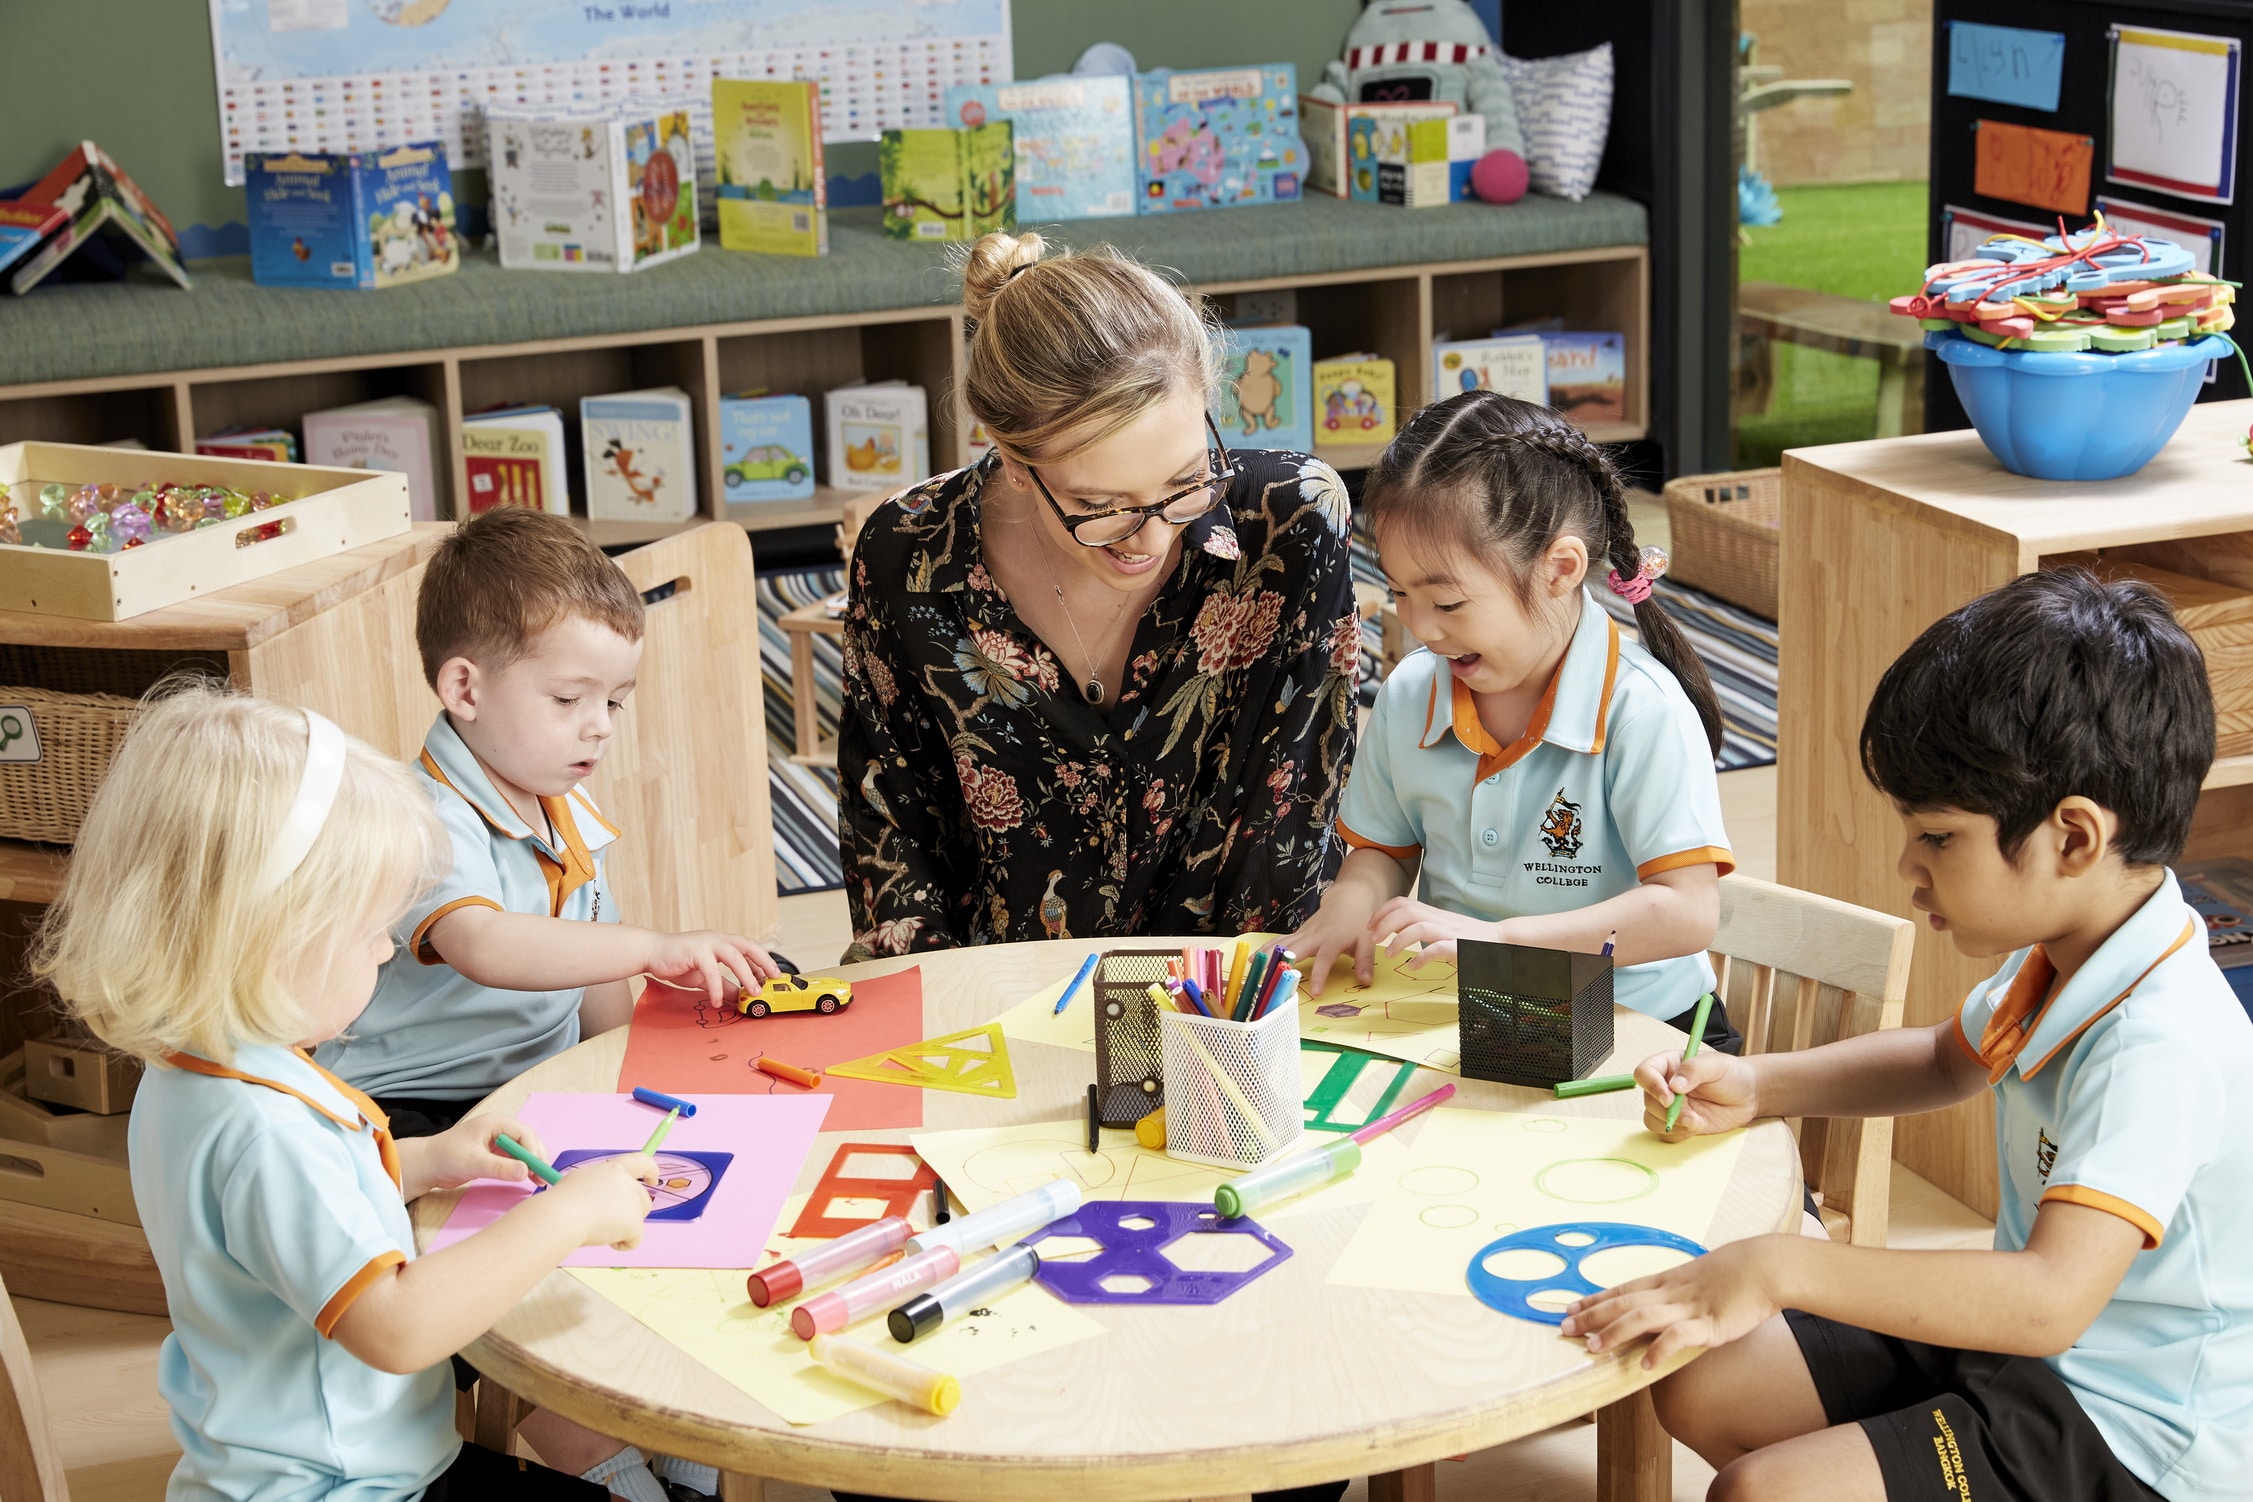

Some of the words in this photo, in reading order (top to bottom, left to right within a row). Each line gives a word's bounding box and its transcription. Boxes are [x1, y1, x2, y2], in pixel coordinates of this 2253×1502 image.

[584, 5, 614, 23] The
[620, 1, 671, 19] World
[274, 173, 320, 187] Animal
[386, 164, 429, 182] Animal
[841, 405, 862, 420] Oh
[865, 406, 901, 421] Dear!
[590, 420, 678, 443] SWING!
[463, 433, 503, 451] Dear
[508, 435, 538, 452] Zoo
[1523, 862, 1602, 874] WELLINGTON
[1536, 876, 1589, 887] COLLEGE
[892, 1272, 922, 1290] MALA
[1932, 1408, 1965, 1474] WELLINGTON
[1933, 1436, 1957, 1491] BANGKOK
